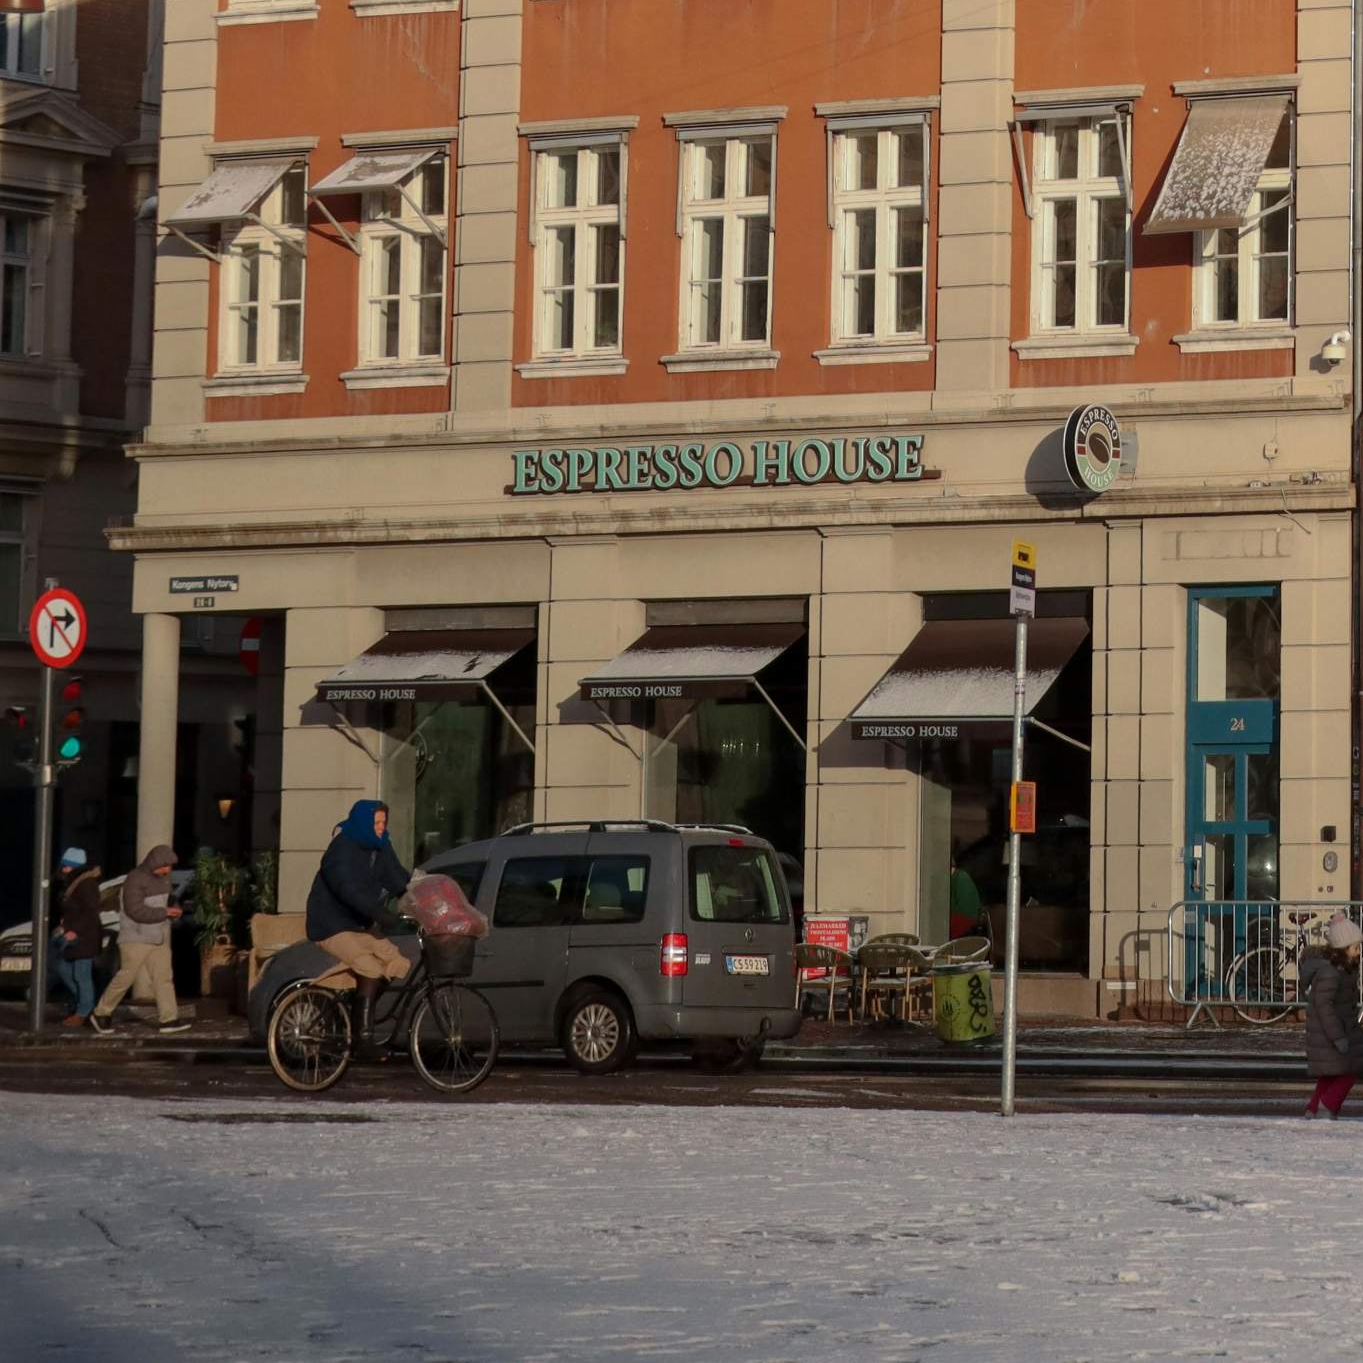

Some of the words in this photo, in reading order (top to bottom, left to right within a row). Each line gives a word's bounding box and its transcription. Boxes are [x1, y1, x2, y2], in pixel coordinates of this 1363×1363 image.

[1080, 408, 1119, 441] ESPRESSO
[512, 441, 745, 495] ESPRESSO
[751, 435, 926, 486] HOUSE
[1084, 465, 1114, 487] HOUSE
[325, 689, 377, 701] ESPRESSO
[379, 688, 417, 700] HOUSE
[590, 686, 642, 698] ESPRESSO
[645, 685, 683, 697] HOUSE
[861, 725, 916, 737] ESPRESSO
[918, 725, 959, 737] HOUSE
[1230, 717, 1245, 731] 24
